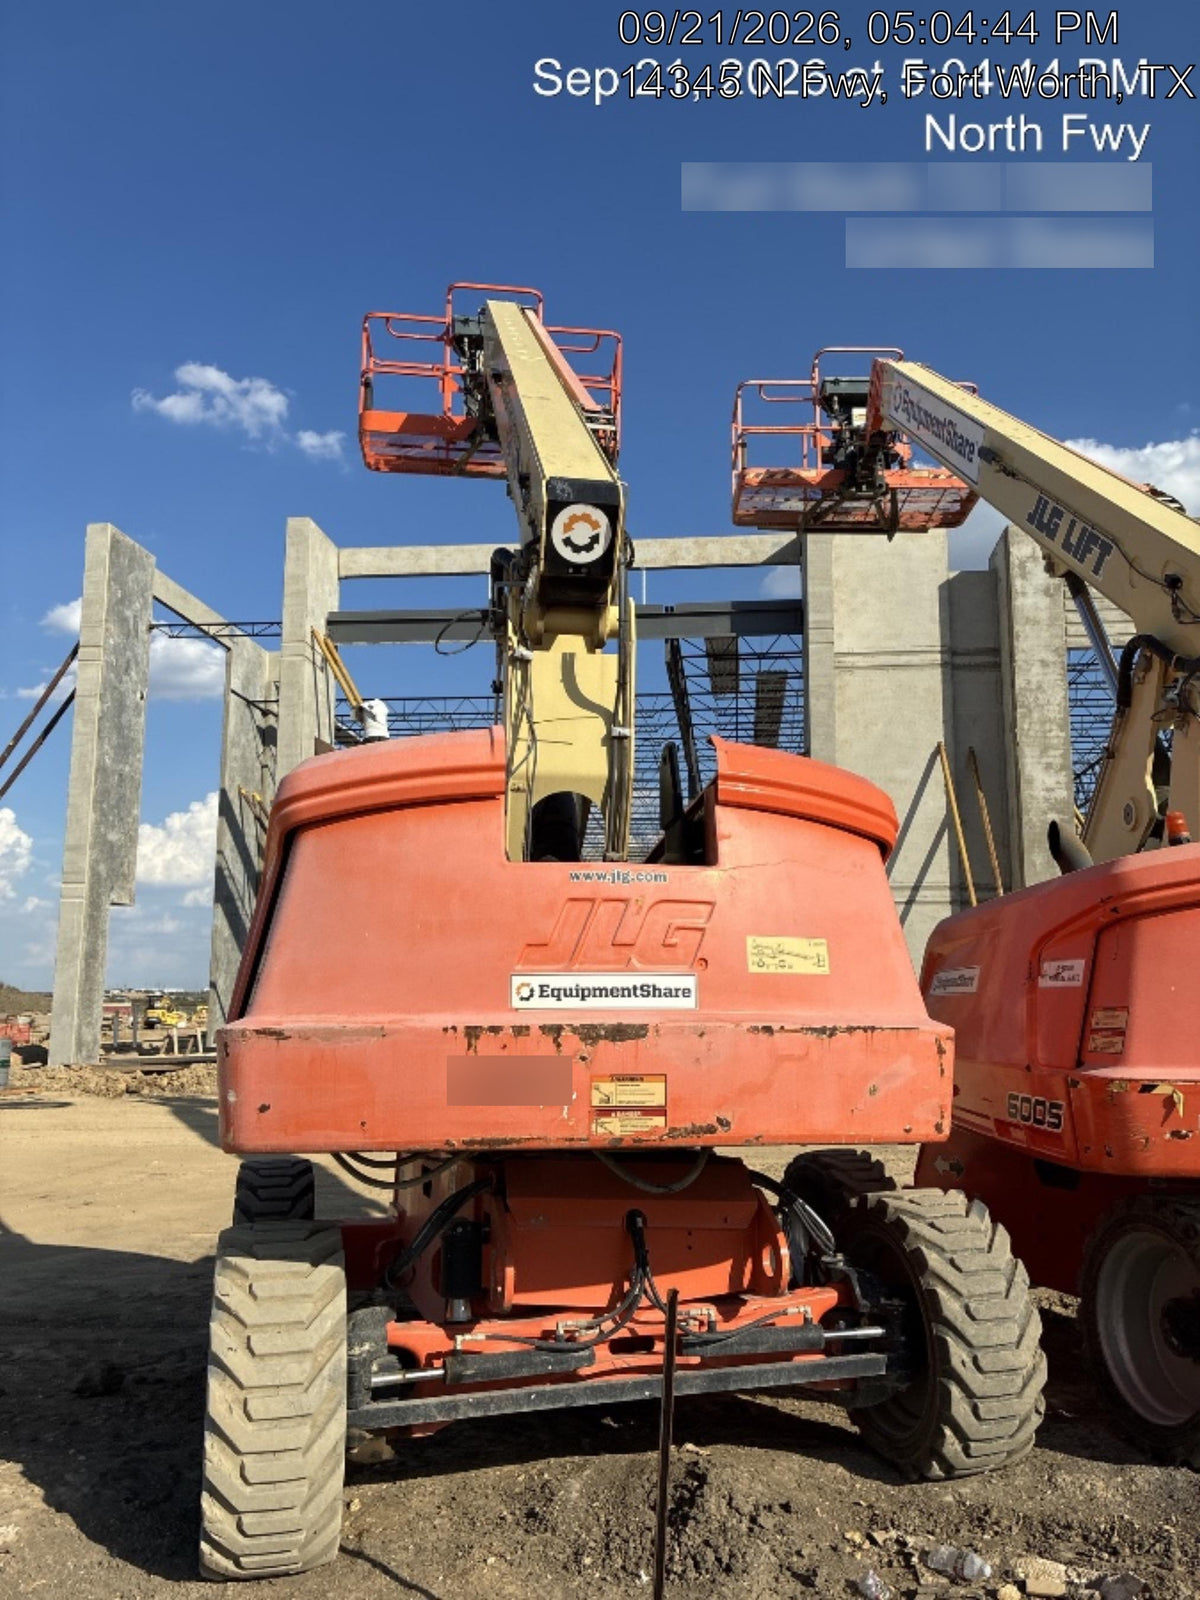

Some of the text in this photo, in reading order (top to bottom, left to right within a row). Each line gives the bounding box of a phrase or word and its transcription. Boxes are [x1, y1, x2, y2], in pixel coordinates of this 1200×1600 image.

[1024, 494, 1115, 580] JLG LIFT
[569, 868, 668, 884] www.jlg.com
[515, 897, 717, 970] JLG
[538, 983, 692, 1002] EquipmentShare
